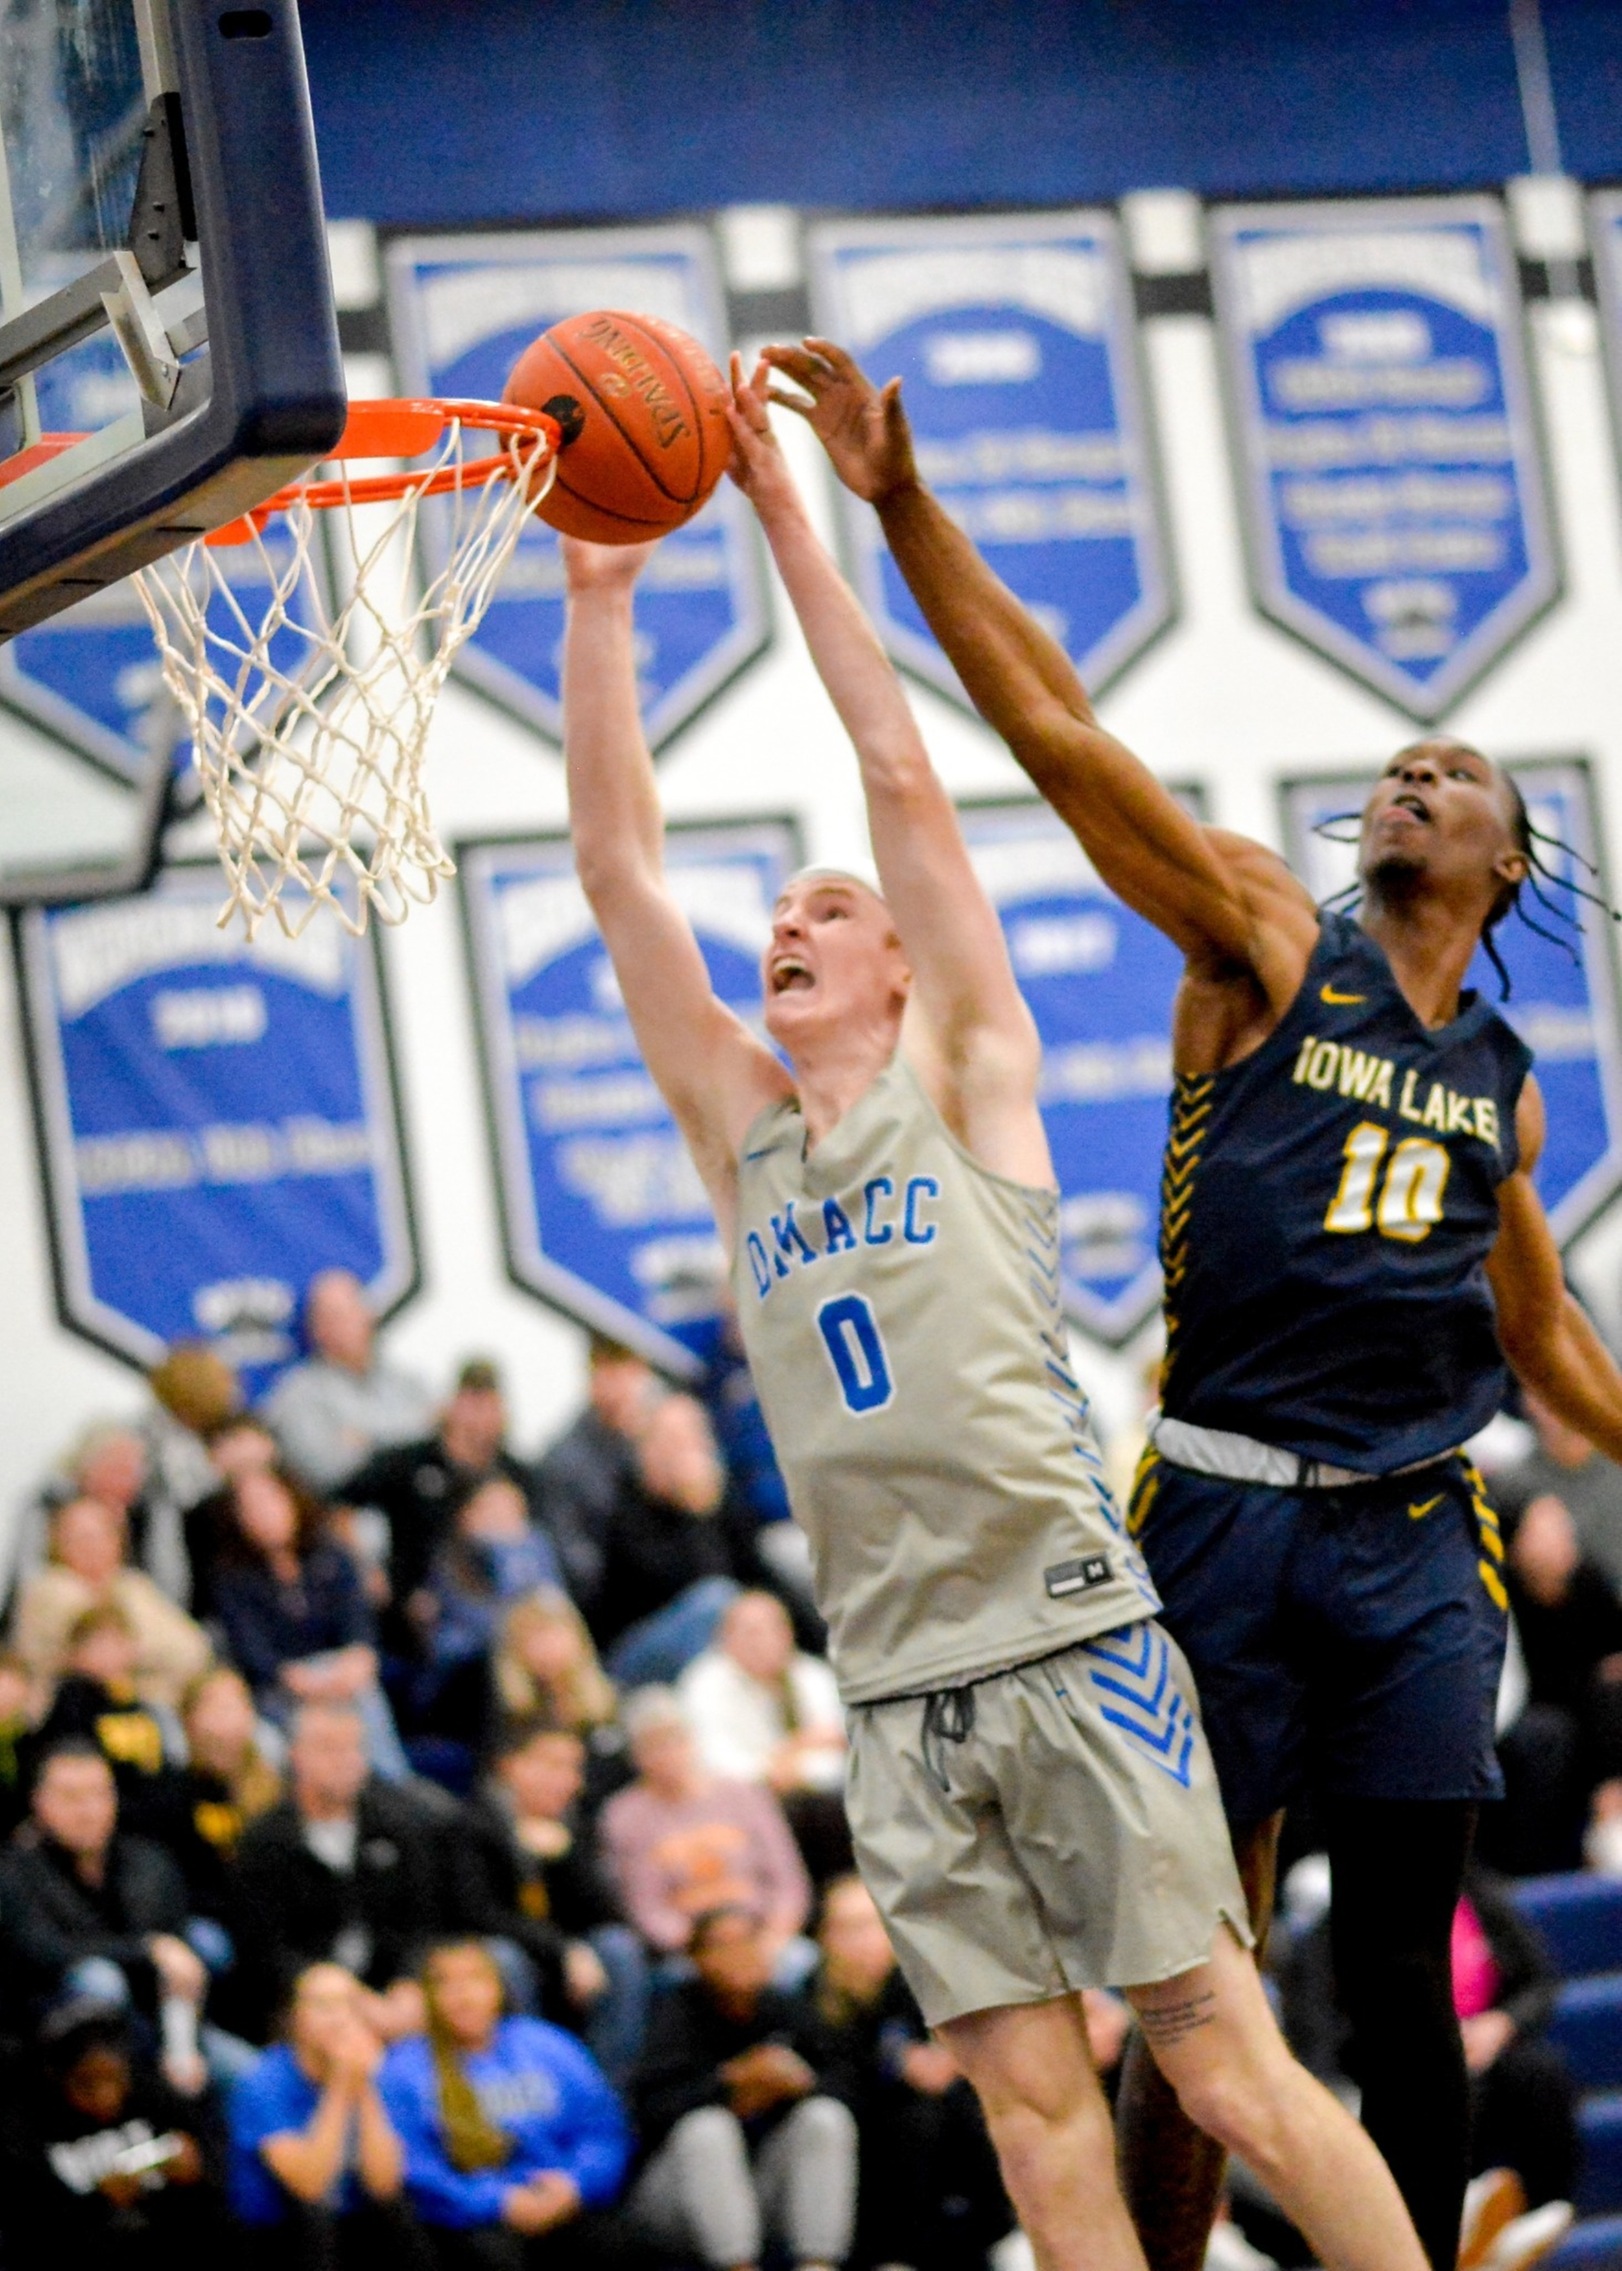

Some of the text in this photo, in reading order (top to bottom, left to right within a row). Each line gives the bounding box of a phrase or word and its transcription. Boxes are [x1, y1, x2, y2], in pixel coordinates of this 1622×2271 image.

[579, 318, 691, 449] SPALDING
[1292, 1034, 1395, 1110] IOWA
[746, 1175, 940, 1300] DMACC
[1323, 1120, 1450, 1243] 10
[814, 1290, 896, 1418] 0
